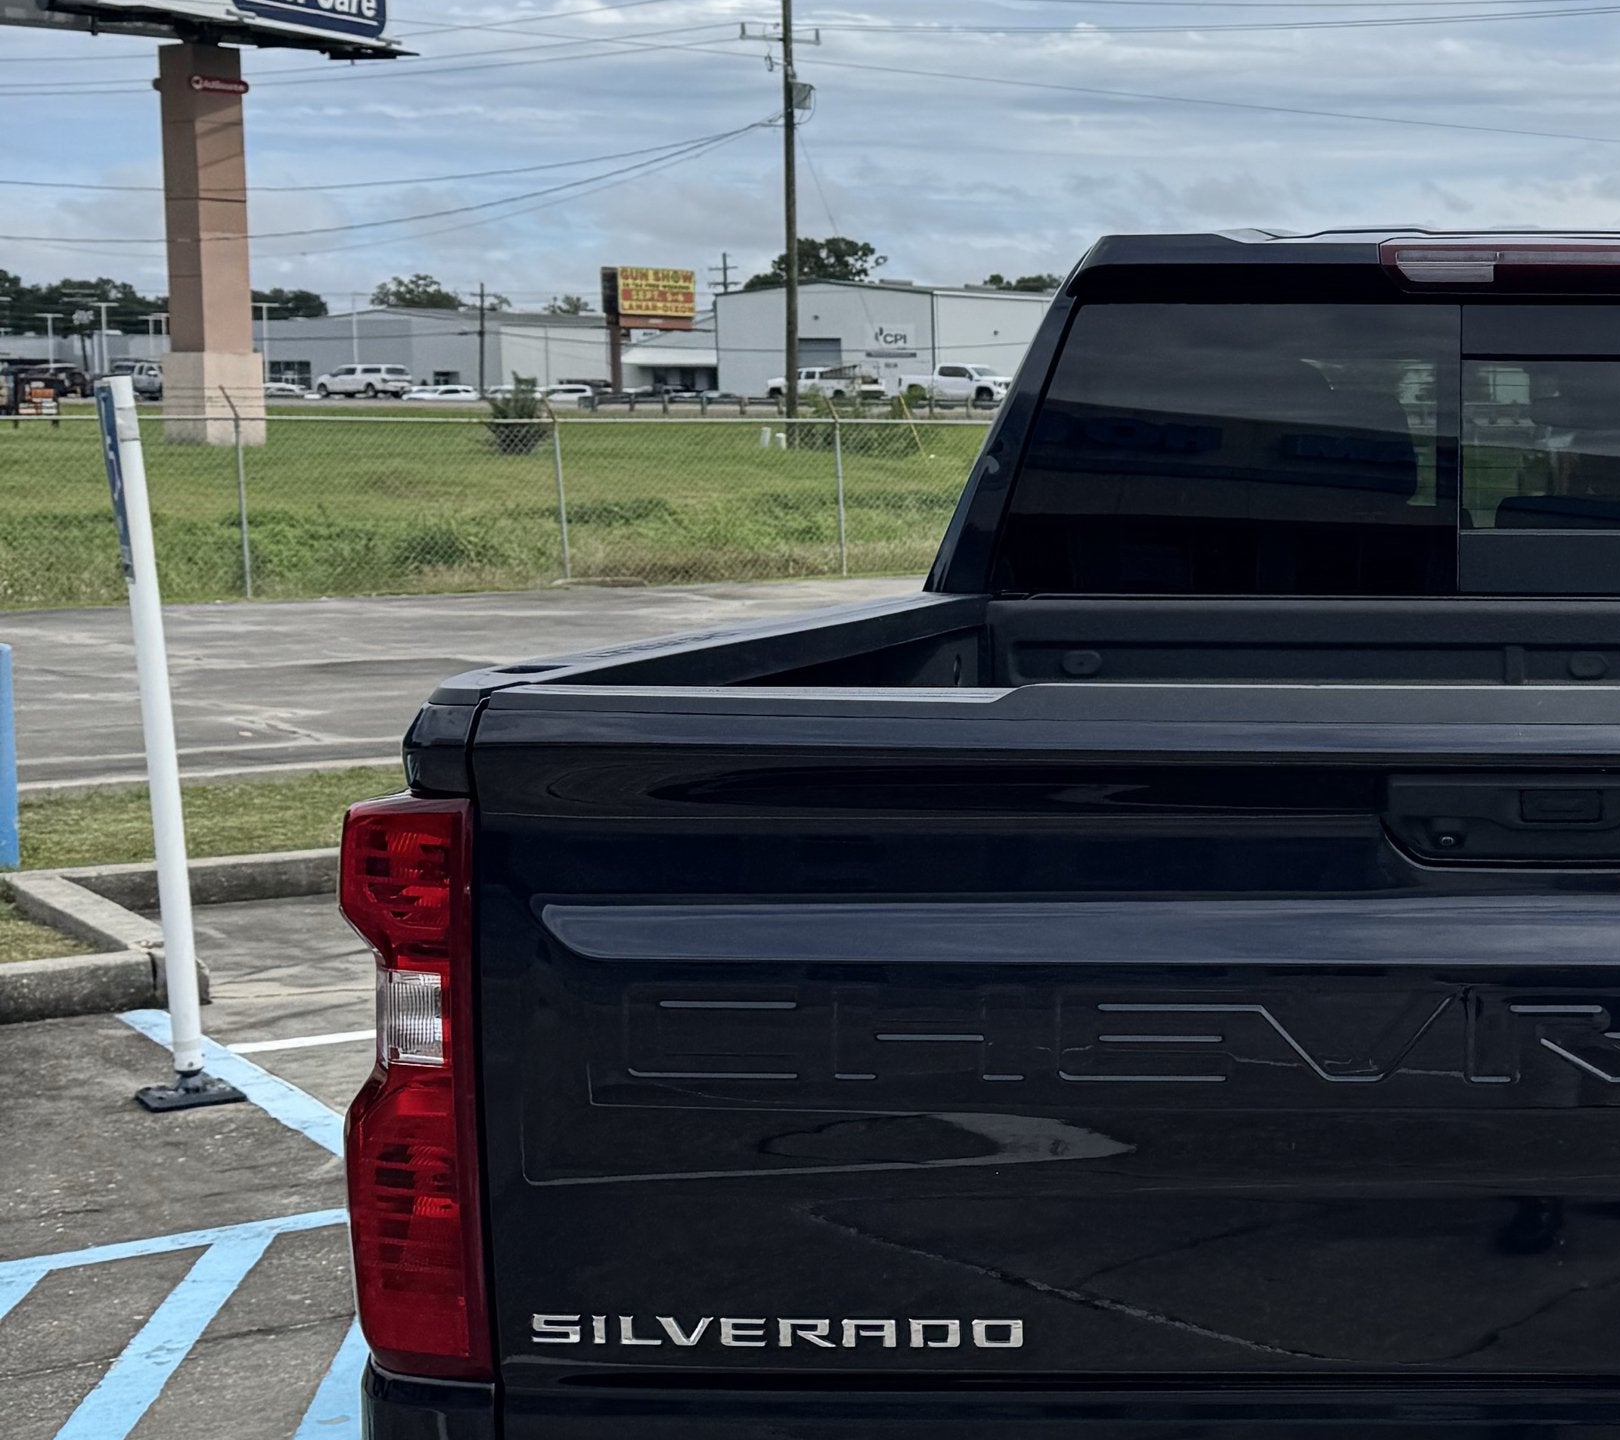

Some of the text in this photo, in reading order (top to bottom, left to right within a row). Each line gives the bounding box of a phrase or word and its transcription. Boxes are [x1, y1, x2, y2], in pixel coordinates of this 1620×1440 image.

[620, 268, 693, 283] GUN SHOW
[883, 333, 907, 344] CPI
[532, 1314, 1024, 1348] SILVERADO
